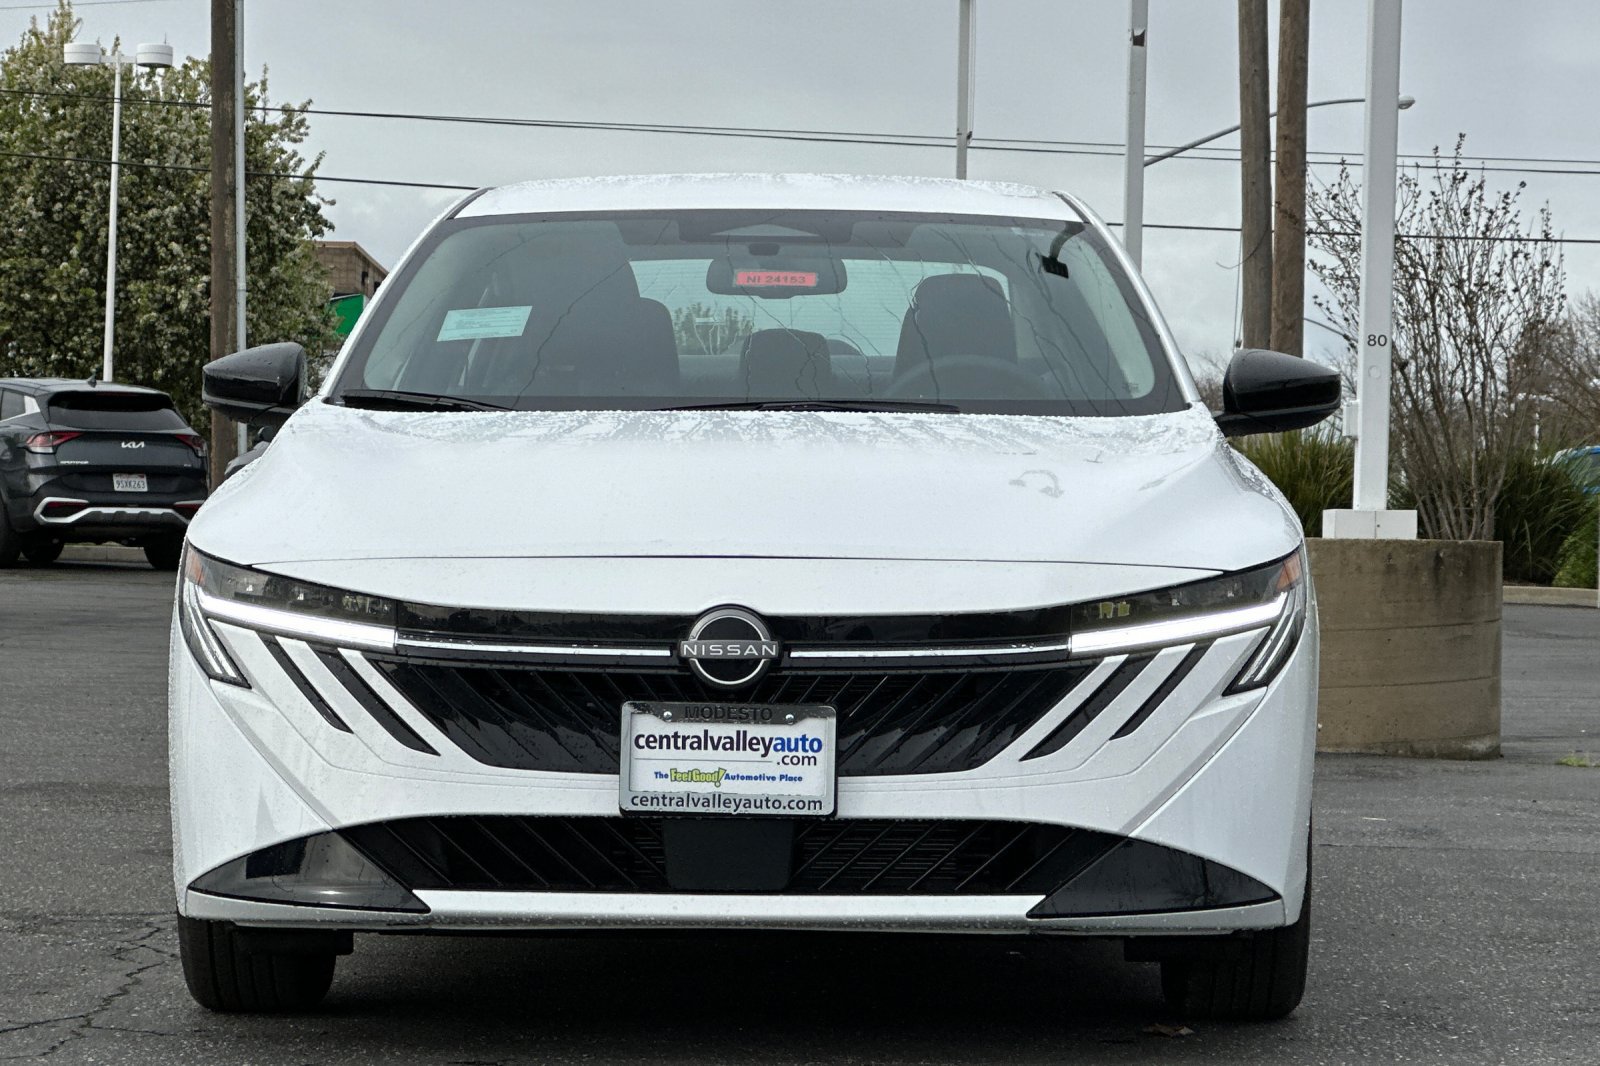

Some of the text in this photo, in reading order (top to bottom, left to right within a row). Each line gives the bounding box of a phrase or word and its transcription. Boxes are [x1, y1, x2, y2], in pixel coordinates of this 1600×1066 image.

[1367, 334, 1388, 347] 80
[683, 644, 776, 656] NISSAN
[685, 705, 773, 721] MODESTO
[634, 729, 823, 758] centralvalleyauto
[776, 754, 817, 766] .com
[654, 771, 669, 780] The
[724, 772, 776, 782] Automotive
[779, 773, 803, 782] Place
[631, 793, 823, 812] centralvalleyauto.com
